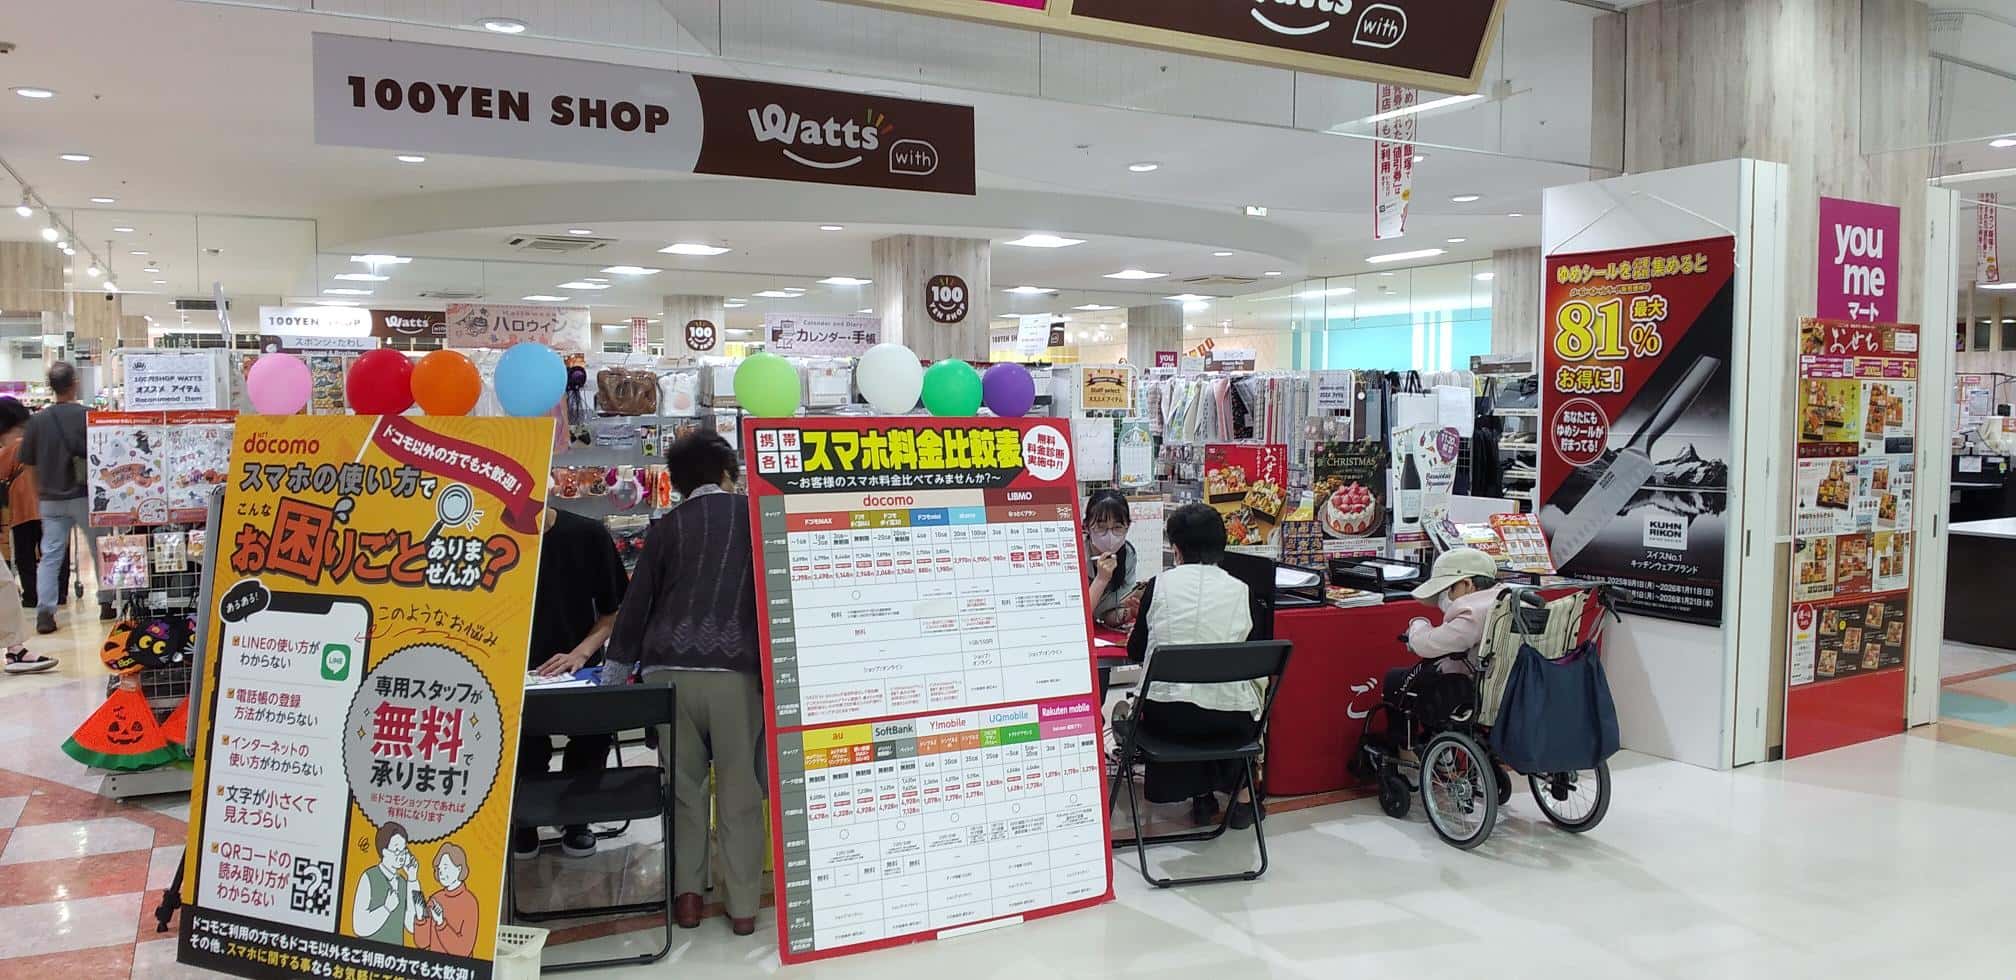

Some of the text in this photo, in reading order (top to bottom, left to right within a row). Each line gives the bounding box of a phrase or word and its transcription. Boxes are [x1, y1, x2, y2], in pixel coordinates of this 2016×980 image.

[1363, 17, 1398, 39] with
[348, 75, 669, 133] 100YEN SHOP
[748, 103, 879, 150] Watts
[895, 150, 931, 167] with
[1834, 223, 1883, 264] you
[1843, 263, 1885, 297] me
[931, 286, 963, 302] 100
[1633, 297, 1666, 319] 最大
[1848, 302, 1879, 322] マート
[268, 317, 319, 327] 100YEN
[385, 315, 429, 329] Watts
[493, 315, 568, 333] ハロウィン
[689, 326, 712, 338] 100
[1556, 298, 1628, 361] 81
[796, 329, 876, 345] カレンダー・手帳
[1631, 324, 1661, 357] %
[1830, 327, 1879, 354] おせち
[1563, 411, 1598, 423] あなたにも
[1037, 433, 1056, 445] 無料
[1556, 425, 1604, 439] ゆめシールが
[243, 434, 320, 455] docomo
[803, 429, 1024, 472] スマホ料金比較表
[1027, 443, 1065, 459] 料金診断
[1326, 456, 1376, 467] CHRISTMAS
[239, 463, 437, 498] スマホの使い方で
[862, 494, 914, 507] docomo
[1007, 491, 1033, 501] LIBMO
[237, 503, 272, 517] こんな
[1649, 521, 1682, 530] KUHN
[1649, 529, 1682, 538] RIKON
[231, 498, 427, 583] お困りごと
[428, 537, 482, 561] ありま
[426, 561, 482, 586] せんか
[1630, 559, 1699, 575] キッチンウェアブランド
[241, 636, 320, 655] LINEの使い方が
[240, 653, 291, 669] わからない
[236, 688, 301, 708] 電話帳の登録
[375, 675, 483, 704] 専用スタッフが
[233, 706, 318, 727] 方法がわからない
[989, 711, 1029, 723] UQmobile
[1041, 703, 1090, 717] Rakuten mobile
[875, 724, 914, 737] SoftBank
[930, 717, 966, 730] Y!mobile
[231, 736, 309, 757] インターネットの
[229, 753, 323, 776] 使い方がわからない
[225, 785, 318, 814] 文字が小さくて
[224, 805, 287, 830] 見えづらい
[387, 807, 446, 823] 有料になります
[220, 842, 291, 869] QRコードの
[218, 861, 290, 890] 読み取り方が
[216, 883, 275, 907] わからない
